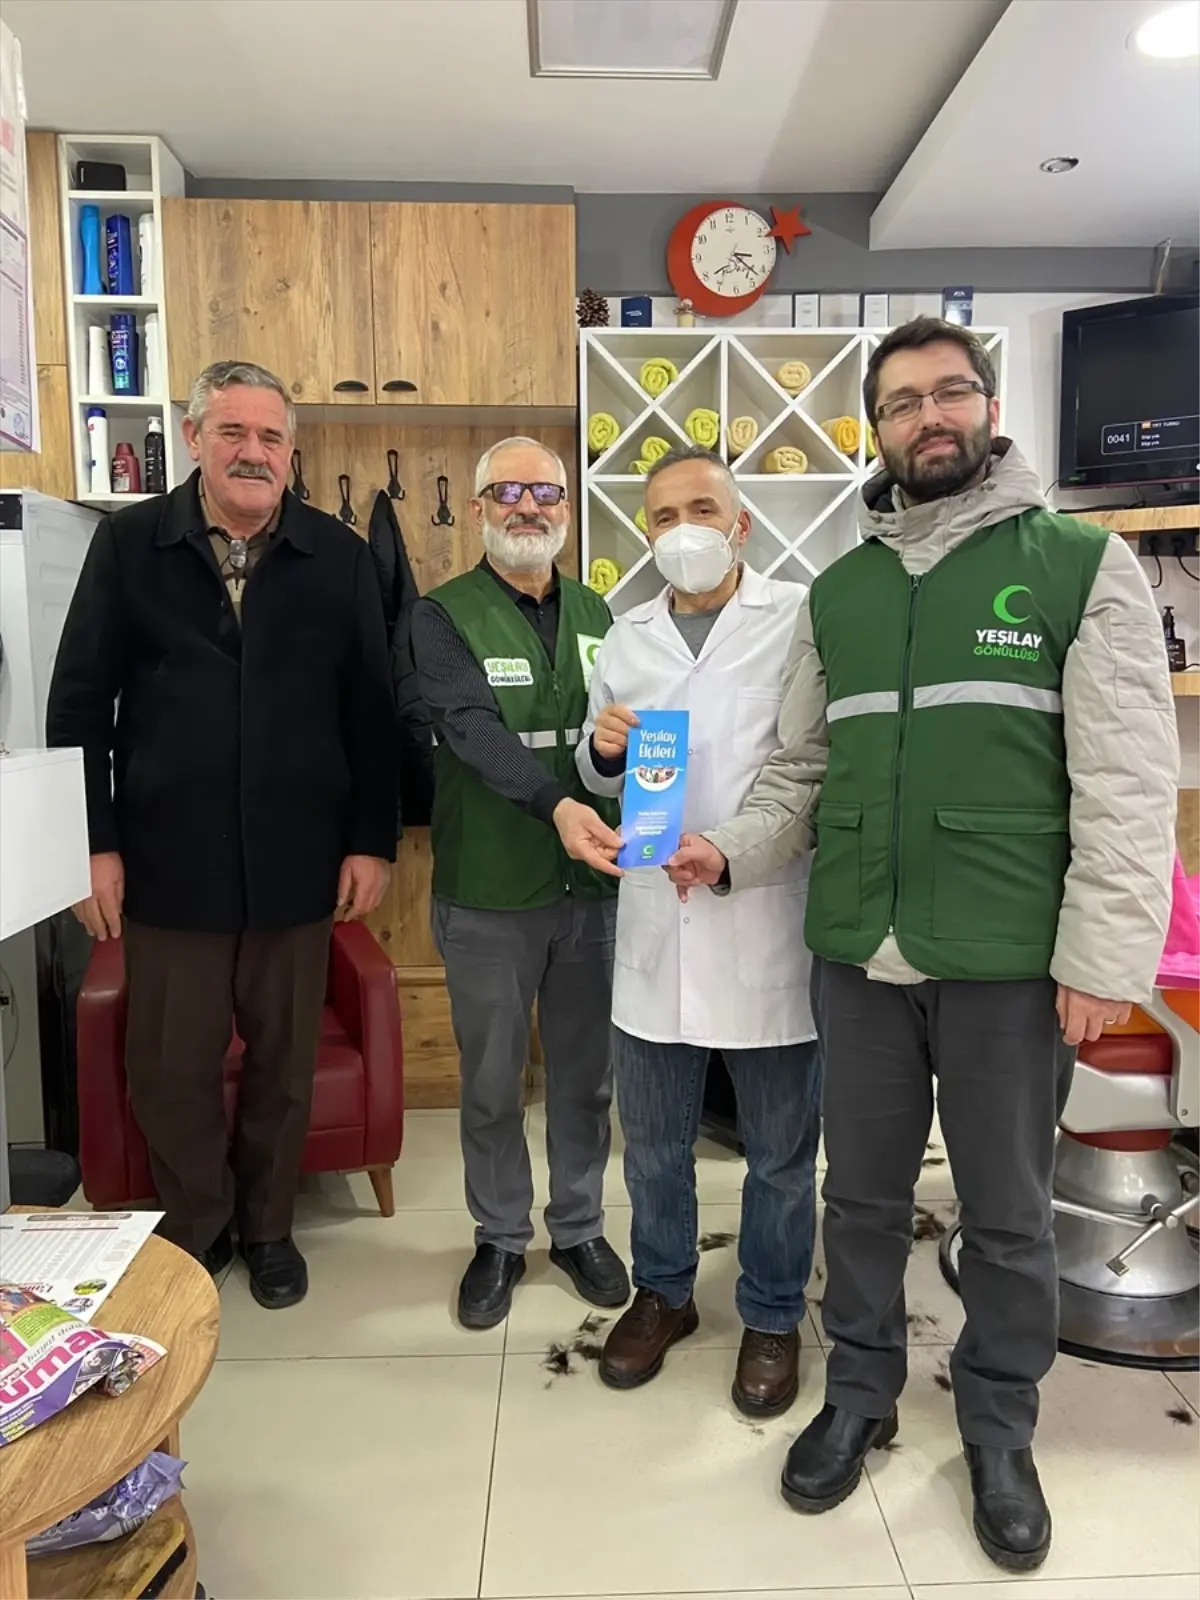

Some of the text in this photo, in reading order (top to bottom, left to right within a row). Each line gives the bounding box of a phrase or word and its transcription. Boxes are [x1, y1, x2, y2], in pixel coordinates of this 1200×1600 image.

[725, 213, 734, 223] 12
[745, 216, 748, 226] 1
[710, 219, 716, 230] 11
[757, 228, 763, 238] 2
[698, 235, 707, 245] 10
[763, 245, 770, 255] 3
[696, 253, 702, 263] 9
[703, 271, 709, 281] 8
[749, 278, 756, 288] 5
[733, 286, 740, 295] 6
[1107, 434, 1130, 444] 0041
[973, 644, 1040, 662] GÖNÜLLÜSÜ
